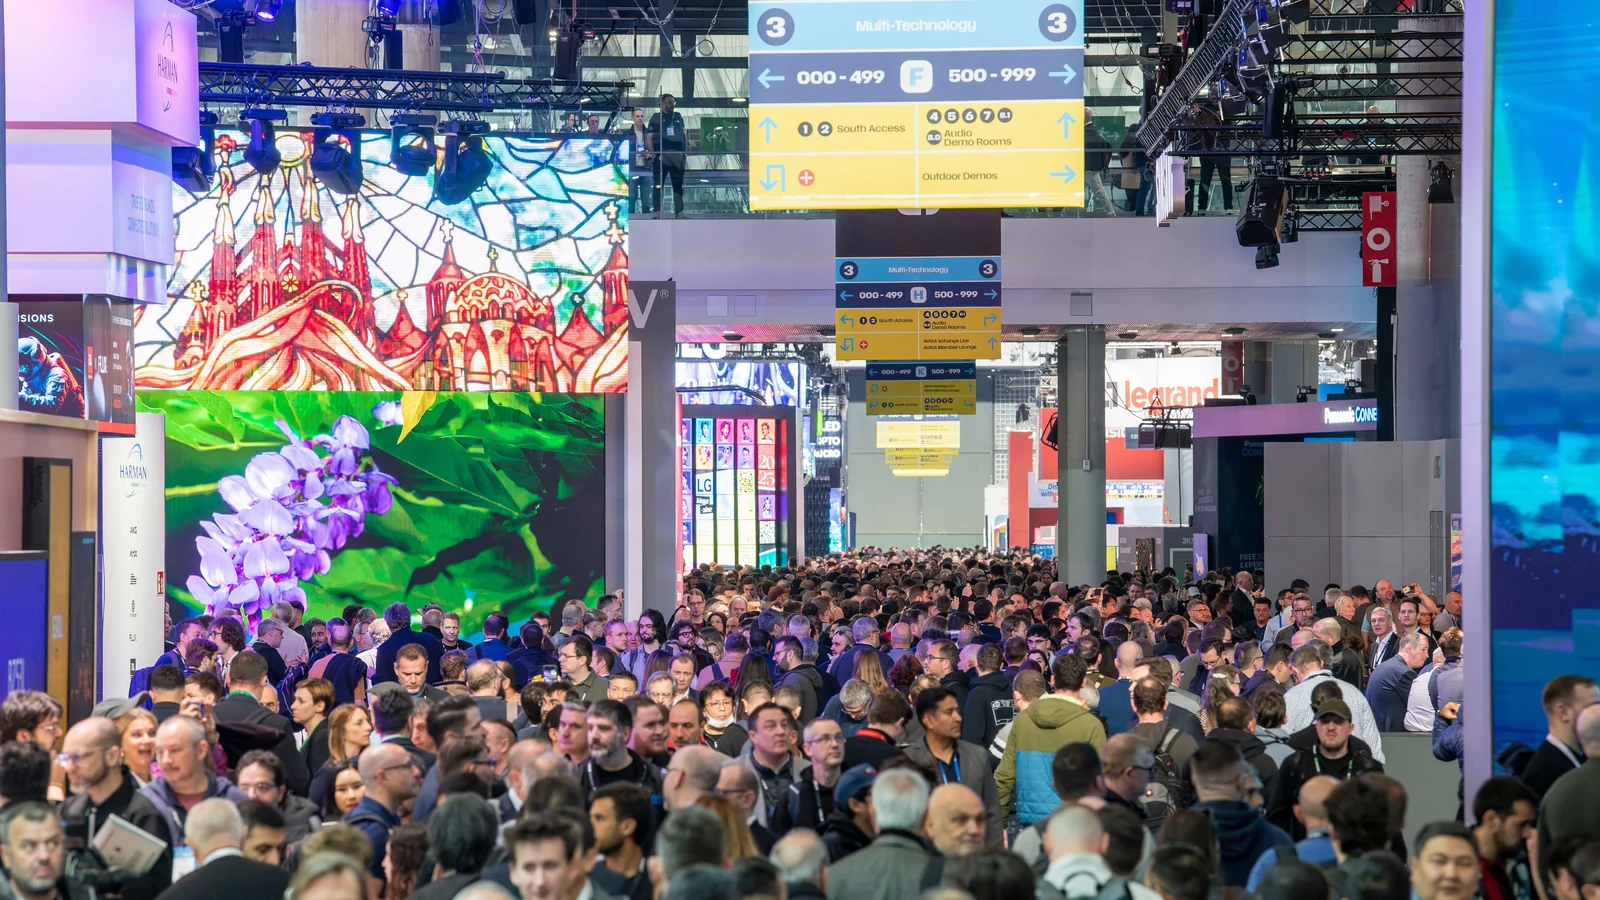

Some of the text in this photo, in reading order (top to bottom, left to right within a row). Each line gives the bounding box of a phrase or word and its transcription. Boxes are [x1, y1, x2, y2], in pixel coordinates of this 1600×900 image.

[766, 16, 786, 38] 3
[856, 19, 976, 33] Multi-Technology
[1047, 12, 1068, 34] 3
[158, 53, 178, 84] HARMAN
[948, 68, 987, 83] 500
[1001, 68, 1036, 82] 999
[797, 70, 836, 85] 000
[850, 70, 885, 84] 499
[909, 68, 924, 86] F
[929, 111, 939, 121] 4
[948, 111, 956, 121] 5
[965, 111, 974, 120] 6
[983, 111, 991, 120] 7
[820, 125, 830, 134] 2
[837, 123, 867, 133] South
[869, 124, 905, 133] Access
[944, 129, 972, 137] Audio
[944, 137, 1012, 146] Demo Rooms
[923, 171, 998, 181] Outdoor Demos
[844, 265, 854, 276] 3
[983, 264, 993, 274] 3
[914, 290, 923, 300] H
[1125, 378, 1218, 416] legrand
[758, 454, 775, 469] 20
[120, 465, 147, 480] HARMAN
[758, 471, 775, 486] 25
[697, 479, 712, 492] LG
